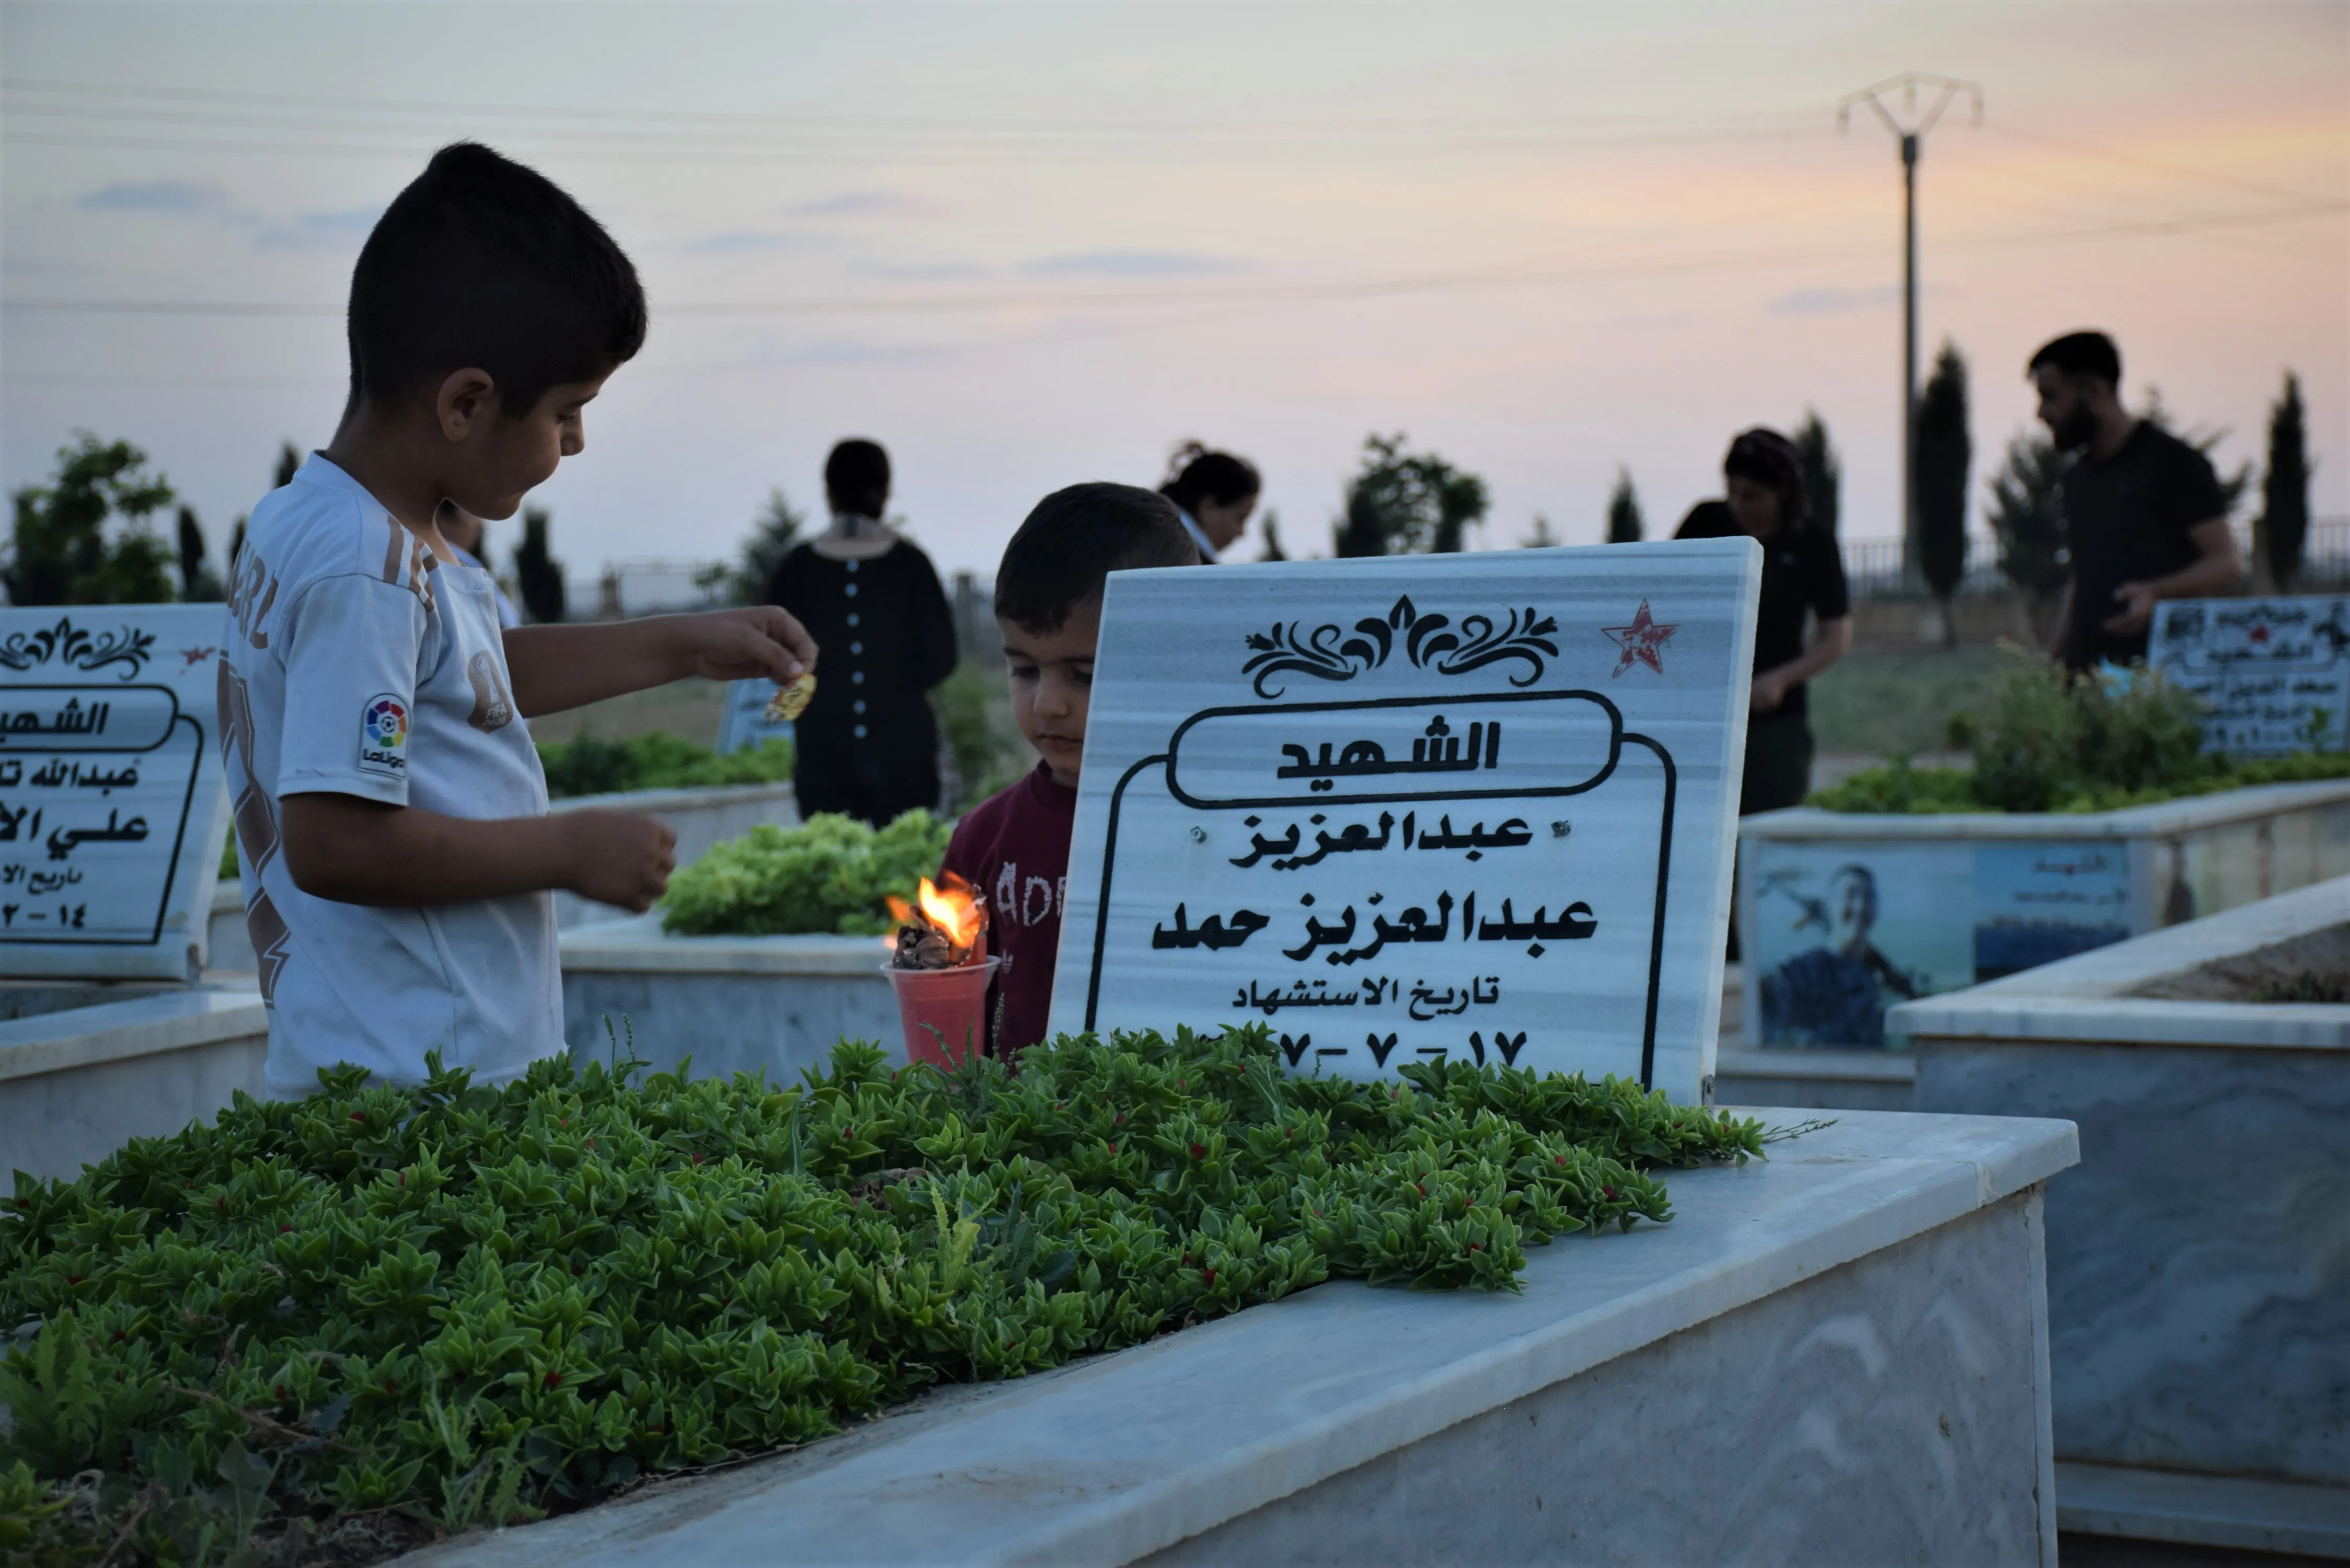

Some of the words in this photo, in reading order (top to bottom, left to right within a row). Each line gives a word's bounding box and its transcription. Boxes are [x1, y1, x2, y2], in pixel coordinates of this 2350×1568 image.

[0, 697, 110, 743] الشهي
[486, 702, 507, 719] FIFA
[363, 749, 404, 768] LaLiga
[1277, 715, 1500, 791] الشهيد
[1229, 811, 1533, 871] عبدالعزيز
[1152, 902, 1270, 951] حمد
[1283, 890, 1598, 966] عبدالعزيز
[1232, 975, 1398, 1016] الاستشهاد
[1409, 976, 1500, 1021] تاريخ
